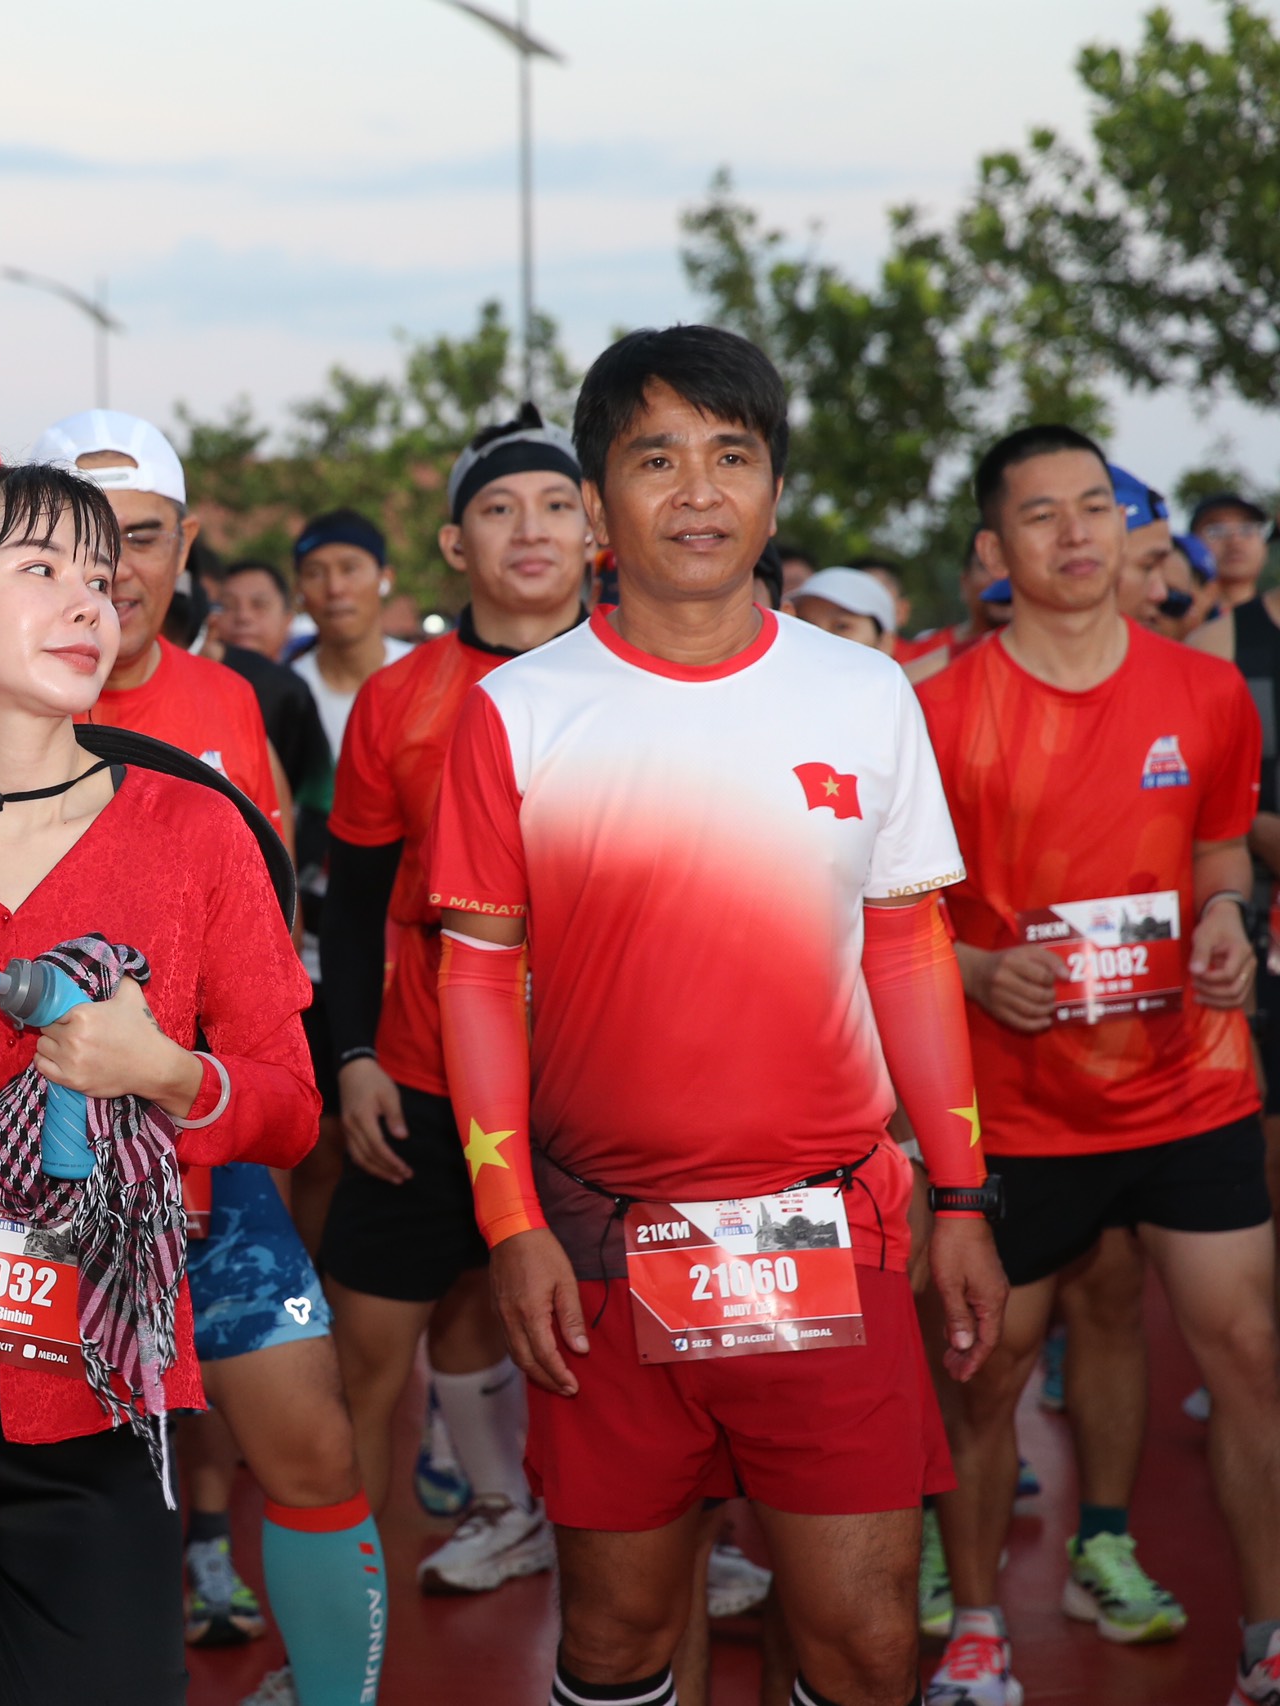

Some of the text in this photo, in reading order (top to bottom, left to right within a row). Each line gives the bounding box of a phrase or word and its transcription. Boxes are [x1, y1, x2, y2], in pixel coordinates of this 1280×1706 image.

[1066, 945, 1150, 983] 21082
[636, 1220, 691, 1244] 21KM
[688, 1255, 799, 1301] 21060
[723, 1303, 752, 1319] ANDY
[736, 1332, 776, 1345] RACEKIT
[800, 1327, 833, 1339] MEDAL
[691, 1338, 713, 1348] SIZE
[37, 1349, 70, 1365] MEDAL
